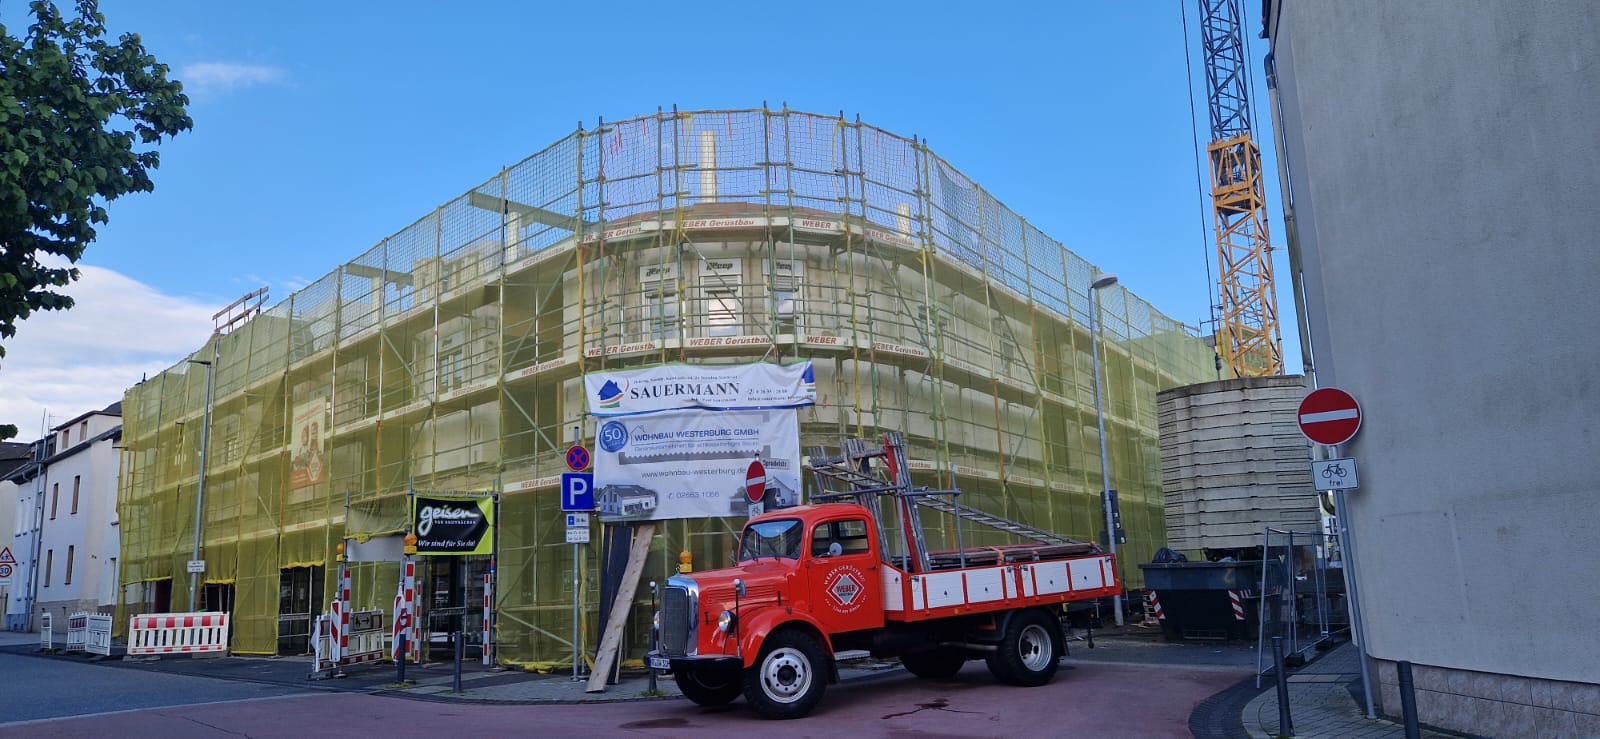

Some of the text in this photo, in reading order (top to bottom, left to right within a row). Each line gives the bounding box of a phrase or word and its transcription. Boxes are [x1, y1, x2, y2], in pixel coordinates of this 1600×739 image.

[679, 220, 707, 228] EBER
[802, 220, 832, 229] WEBER
[690, 338, 723, 347] WEBER
[807, 336, 837, 345] WEBER
[588, 345, 618, 357] WEER
[630, 382, 741, 400] SAUERMANN
[604, 428, 621, 442] 50
[635, 428, 759, 441] WOHNBAU WESTERBURG GMBH
[641, 467, 747, 478] www.wohnbau-westerburg.de
[1329, 479, 1344, 487] frei
[570, 477, 588, 506] P
[417, 504, 480, 537] geisen
[445, 540, 456, 548] für
[466, 539, 476, 547] da!
